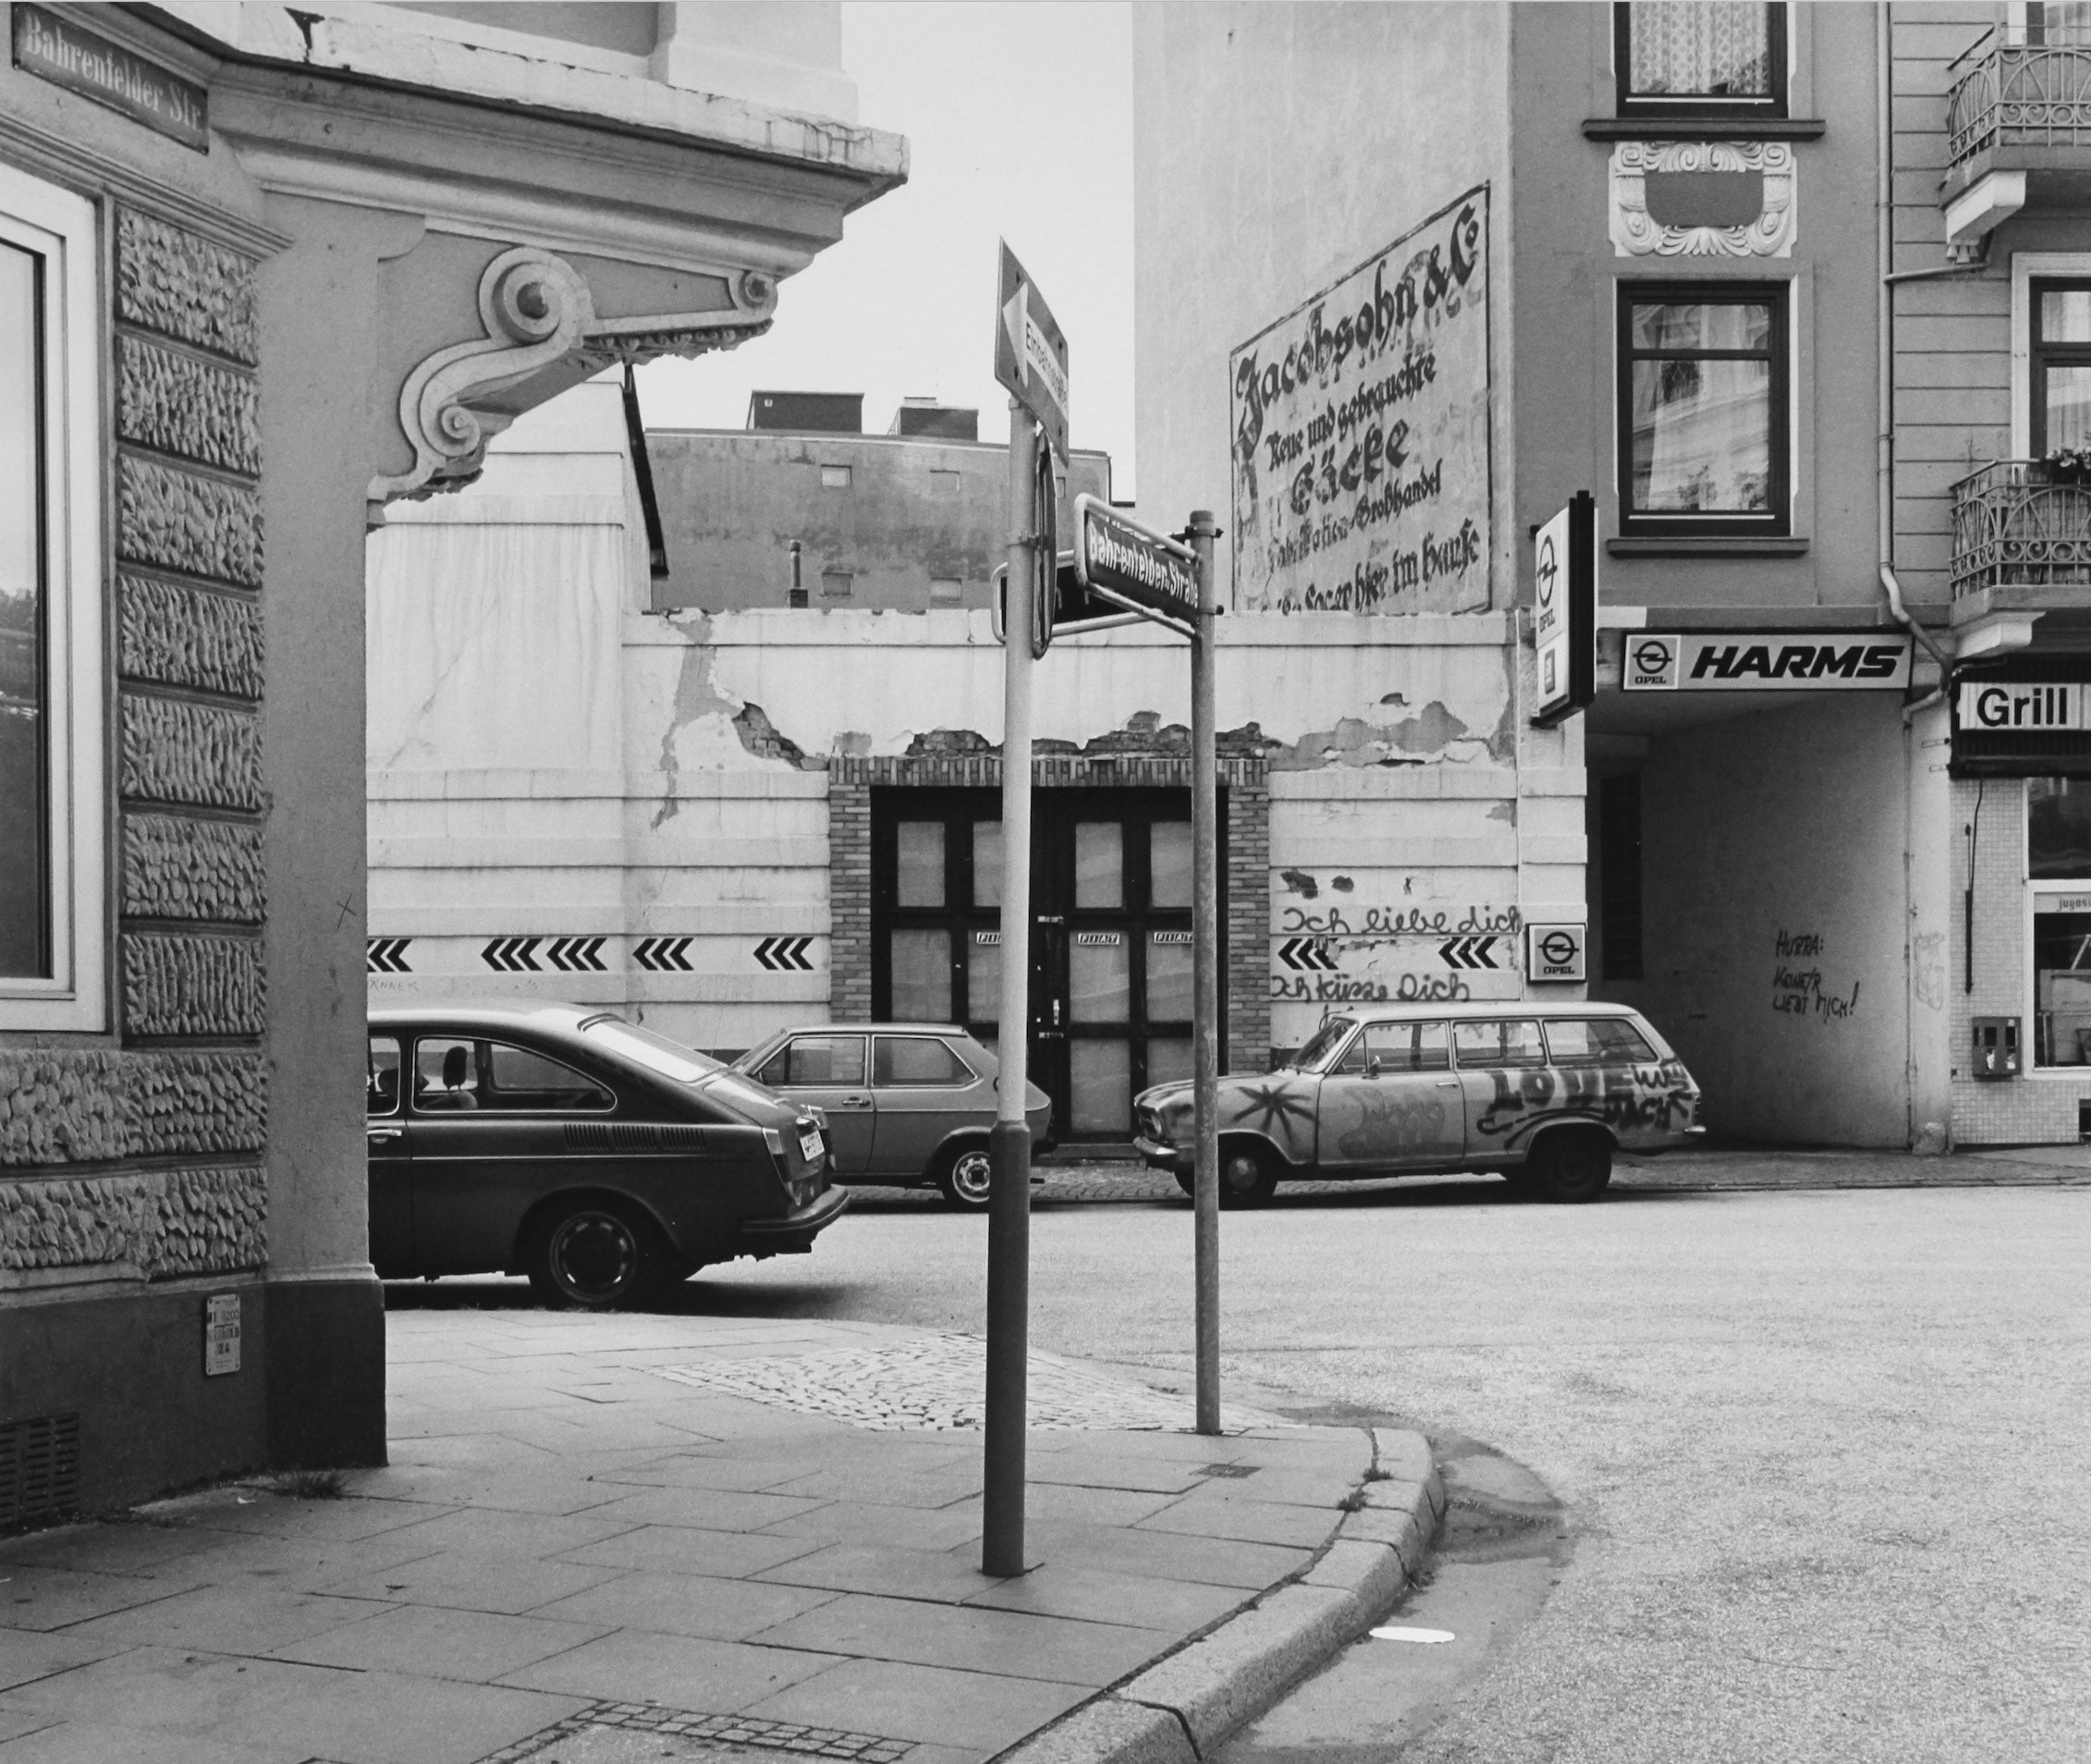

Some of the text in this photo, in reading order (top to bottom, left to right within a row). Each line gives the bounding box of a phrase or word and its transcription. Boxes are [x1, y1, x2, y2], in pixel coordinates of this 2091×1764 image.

[1233, 259, 1419, 460] Jacobsohn
[1424, 244, 1449, 308] &
[1307, 398, 1337, 448] und
[1338, 352, 1437, 443] gebrauchte
[1290, 419, 1411, 516] Säcke
[1393, 549, 1419, 595] im
[1633, 676, 1669, 685] OPEL
[1689, 644, 1905, 680] HARMS
[1976, 687, 2068, 728] Grill
[1361, 906, 1452, 935] liebe
[1457, 904, 1522, 934] dich
[1078, 933, 1119, 945] FIAT
[1543, 966, 1575, 975] OPEL
